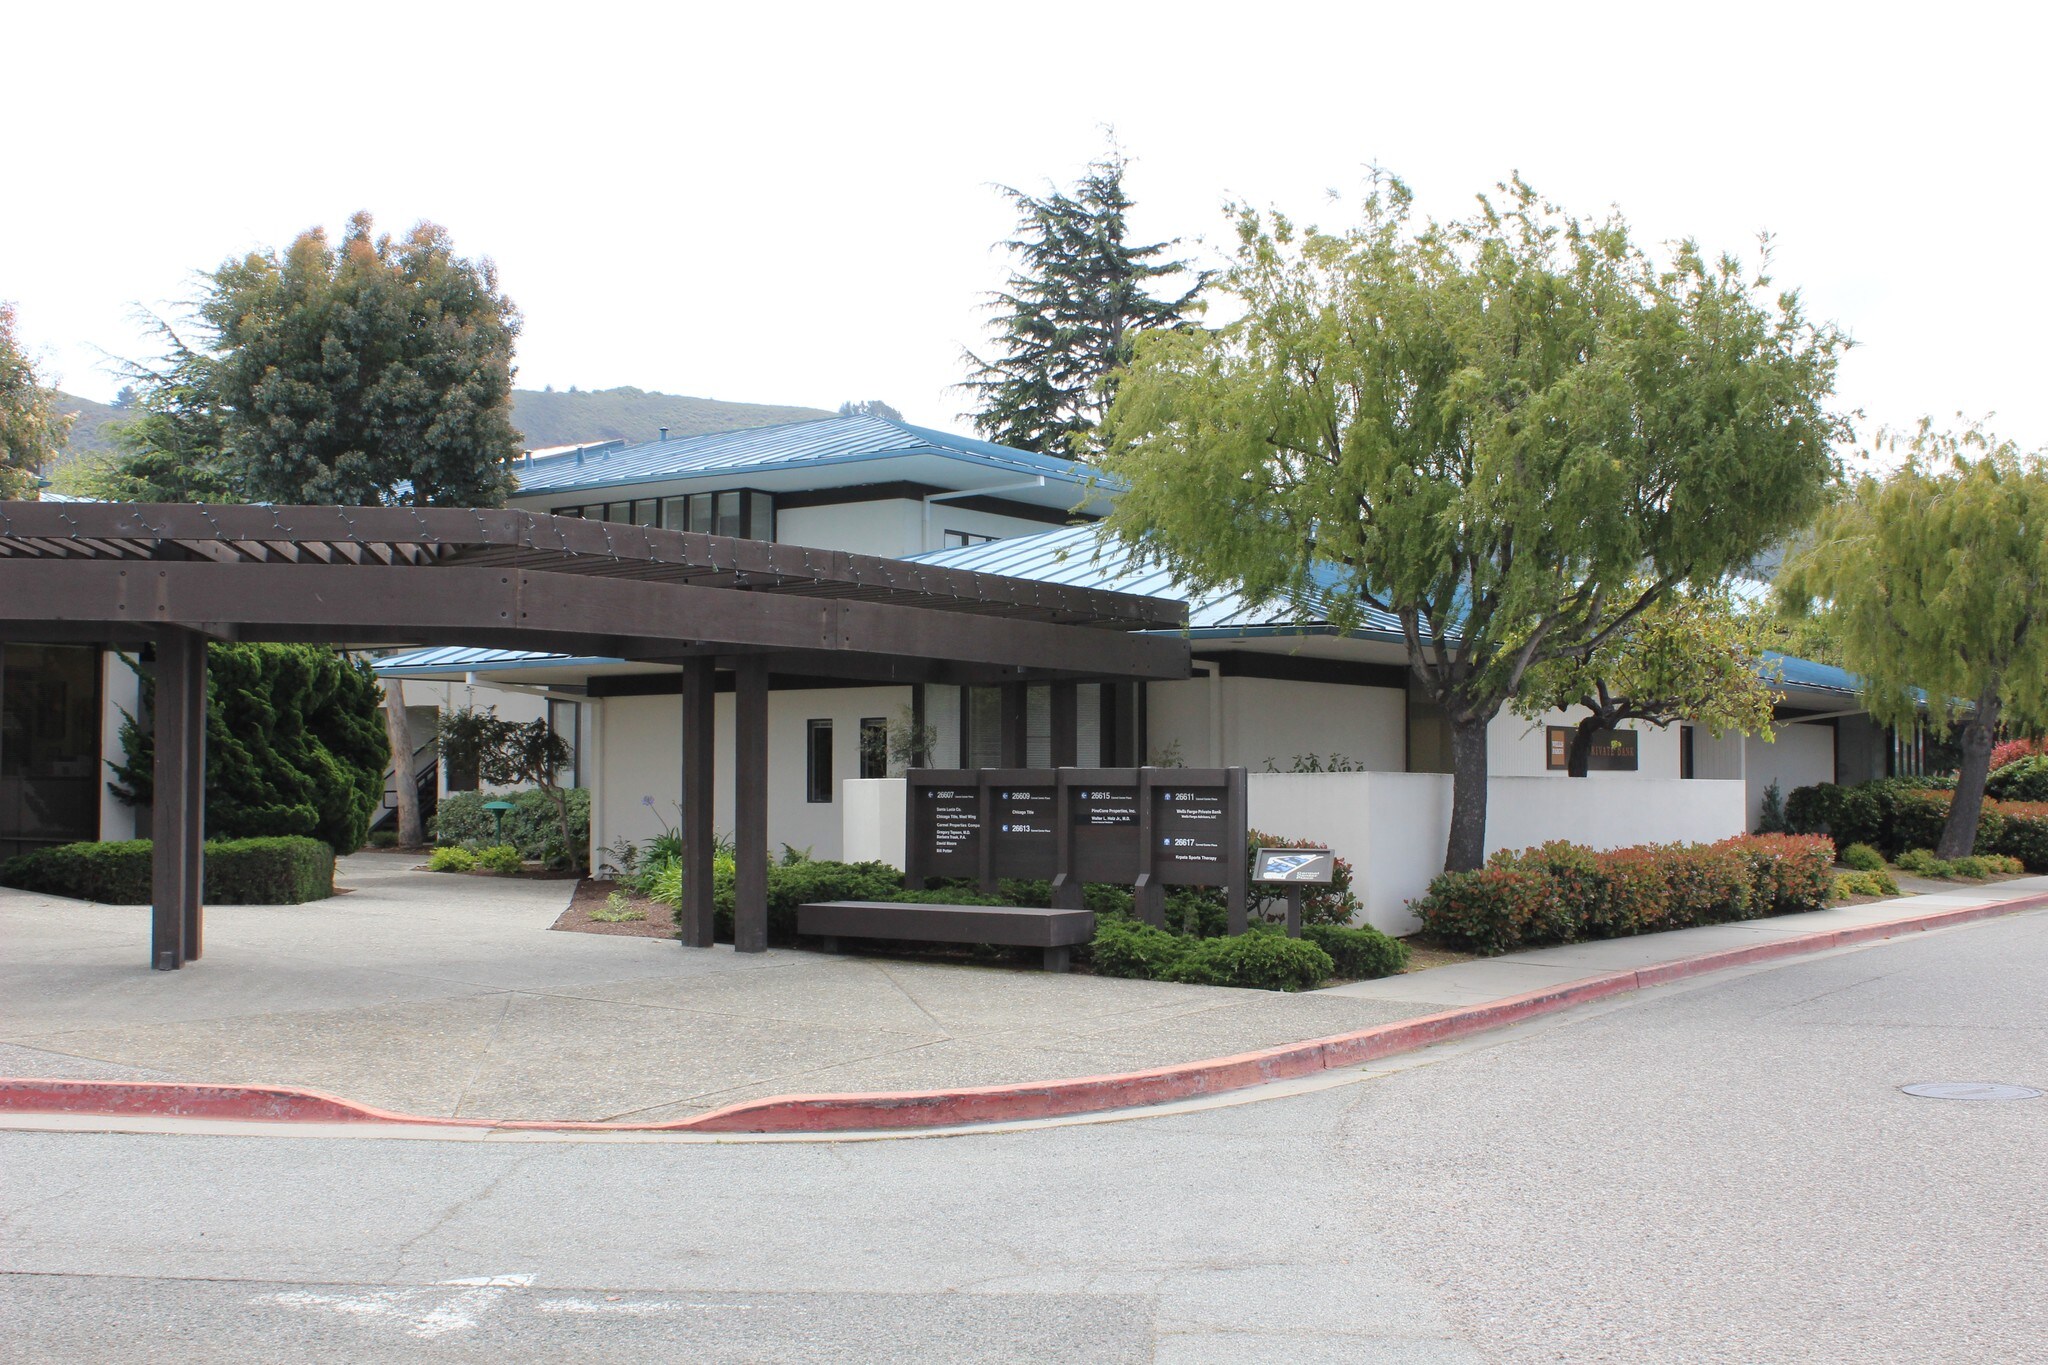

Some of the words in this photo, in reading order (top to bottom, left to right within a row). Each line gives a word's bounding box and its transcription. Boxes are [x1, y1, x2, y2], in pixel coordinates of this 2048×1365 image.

[1617, 746, 1634, 757] BANK
[937, 791, 955, 799] 26607
[1011, 792, 1031, 800] 26609
[1091, 791, 1111, 800] 26615
[1175, 792, 1194, 801] 26611
[1011, 824, 1031, 833] 26613
[1174, 838, 1195, 847] 26617
